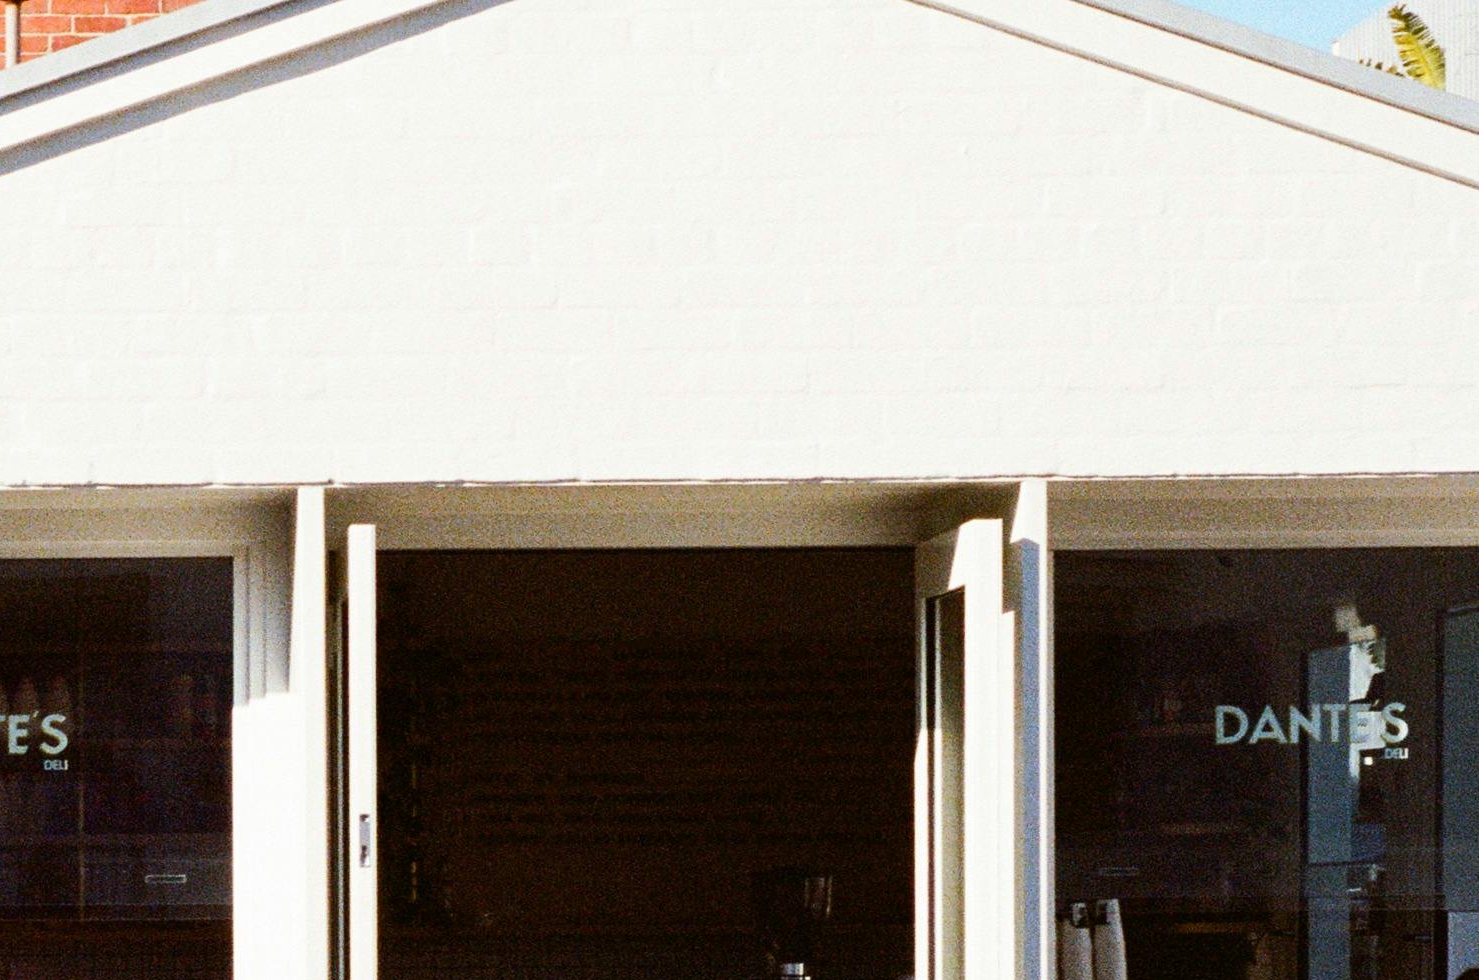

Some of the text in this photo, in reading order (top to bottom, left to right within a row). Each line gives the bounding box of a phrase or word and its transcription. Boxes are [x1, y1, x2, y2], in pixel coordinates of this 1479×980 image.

[1214, 700, 1409, 745] DANTE'S
[1384, 747, 1409, 760] DELI
[43, 759, 69, 771] DELI
